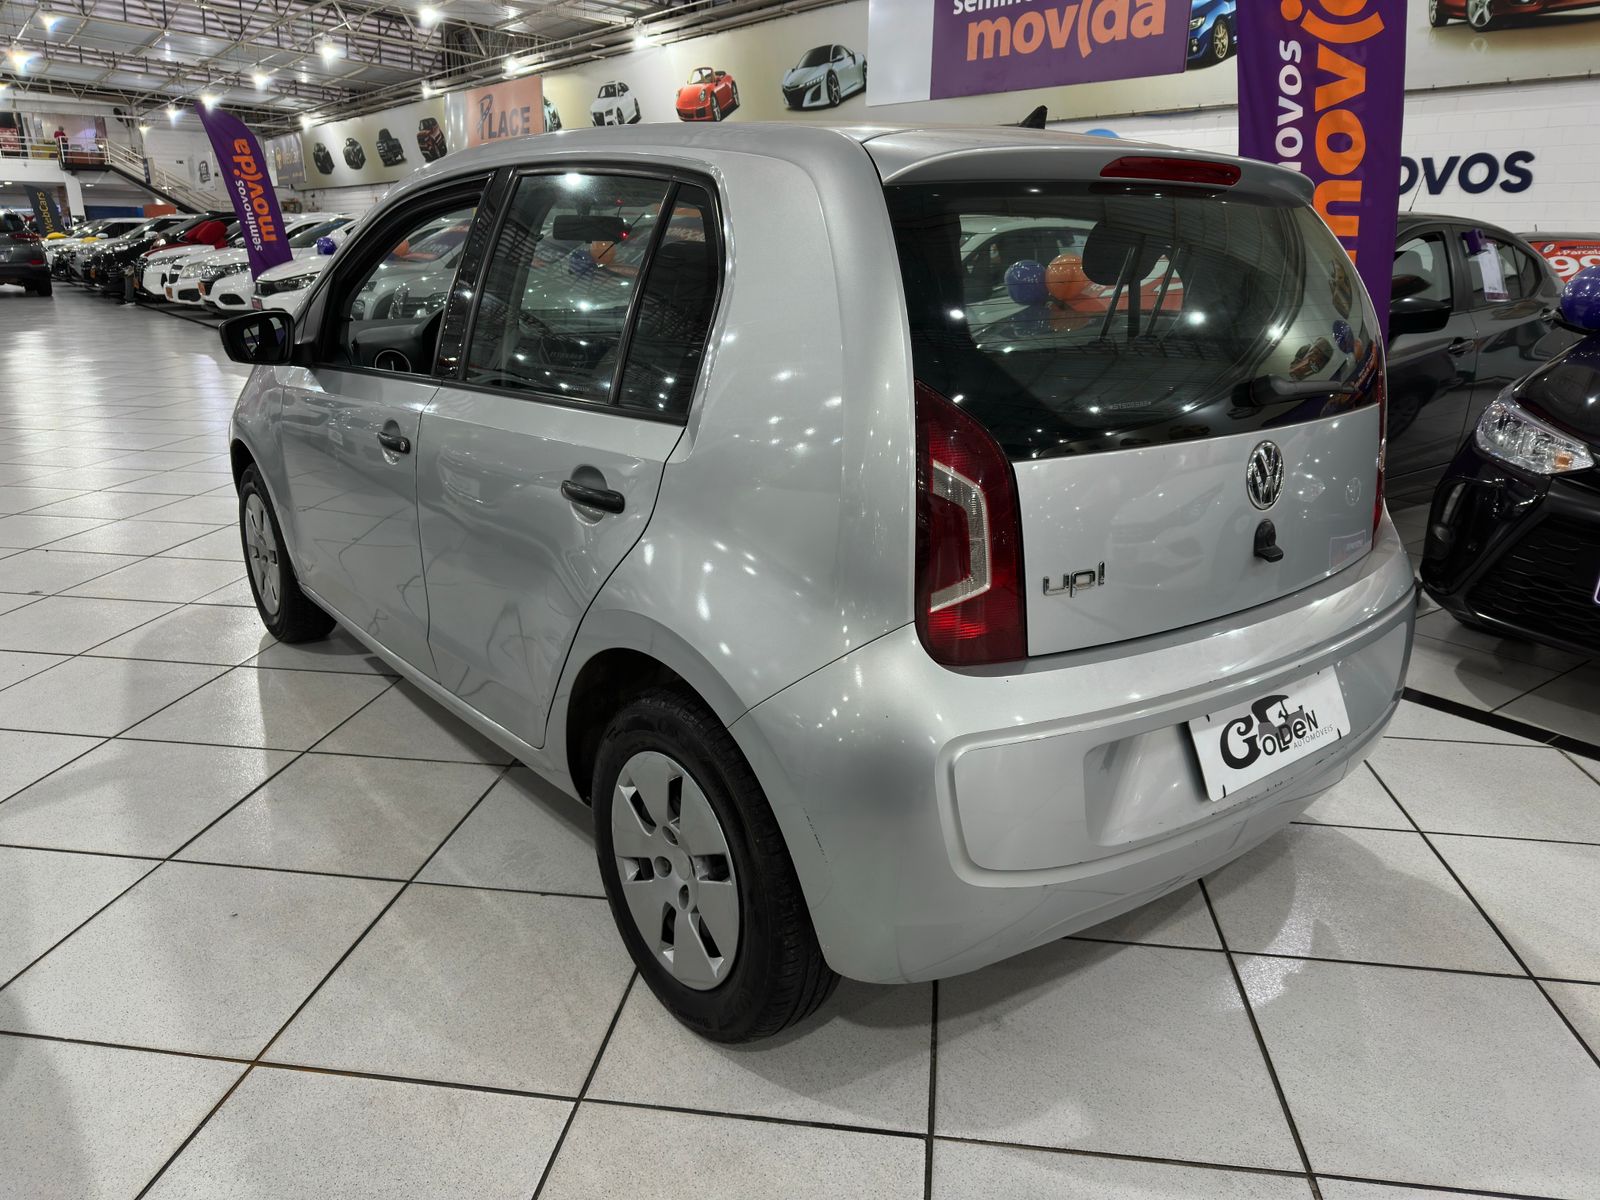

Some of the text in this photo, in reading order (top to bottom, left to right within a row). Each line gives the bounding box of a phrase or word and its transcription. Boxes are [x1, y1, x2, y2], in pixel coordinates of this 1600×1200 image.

[477, 94, 530, 140] PLACE
[232, 138, 278, 242] movida
[235, 180, 263, 252] seminovos
[1043, 561, 1105, 598] up!
